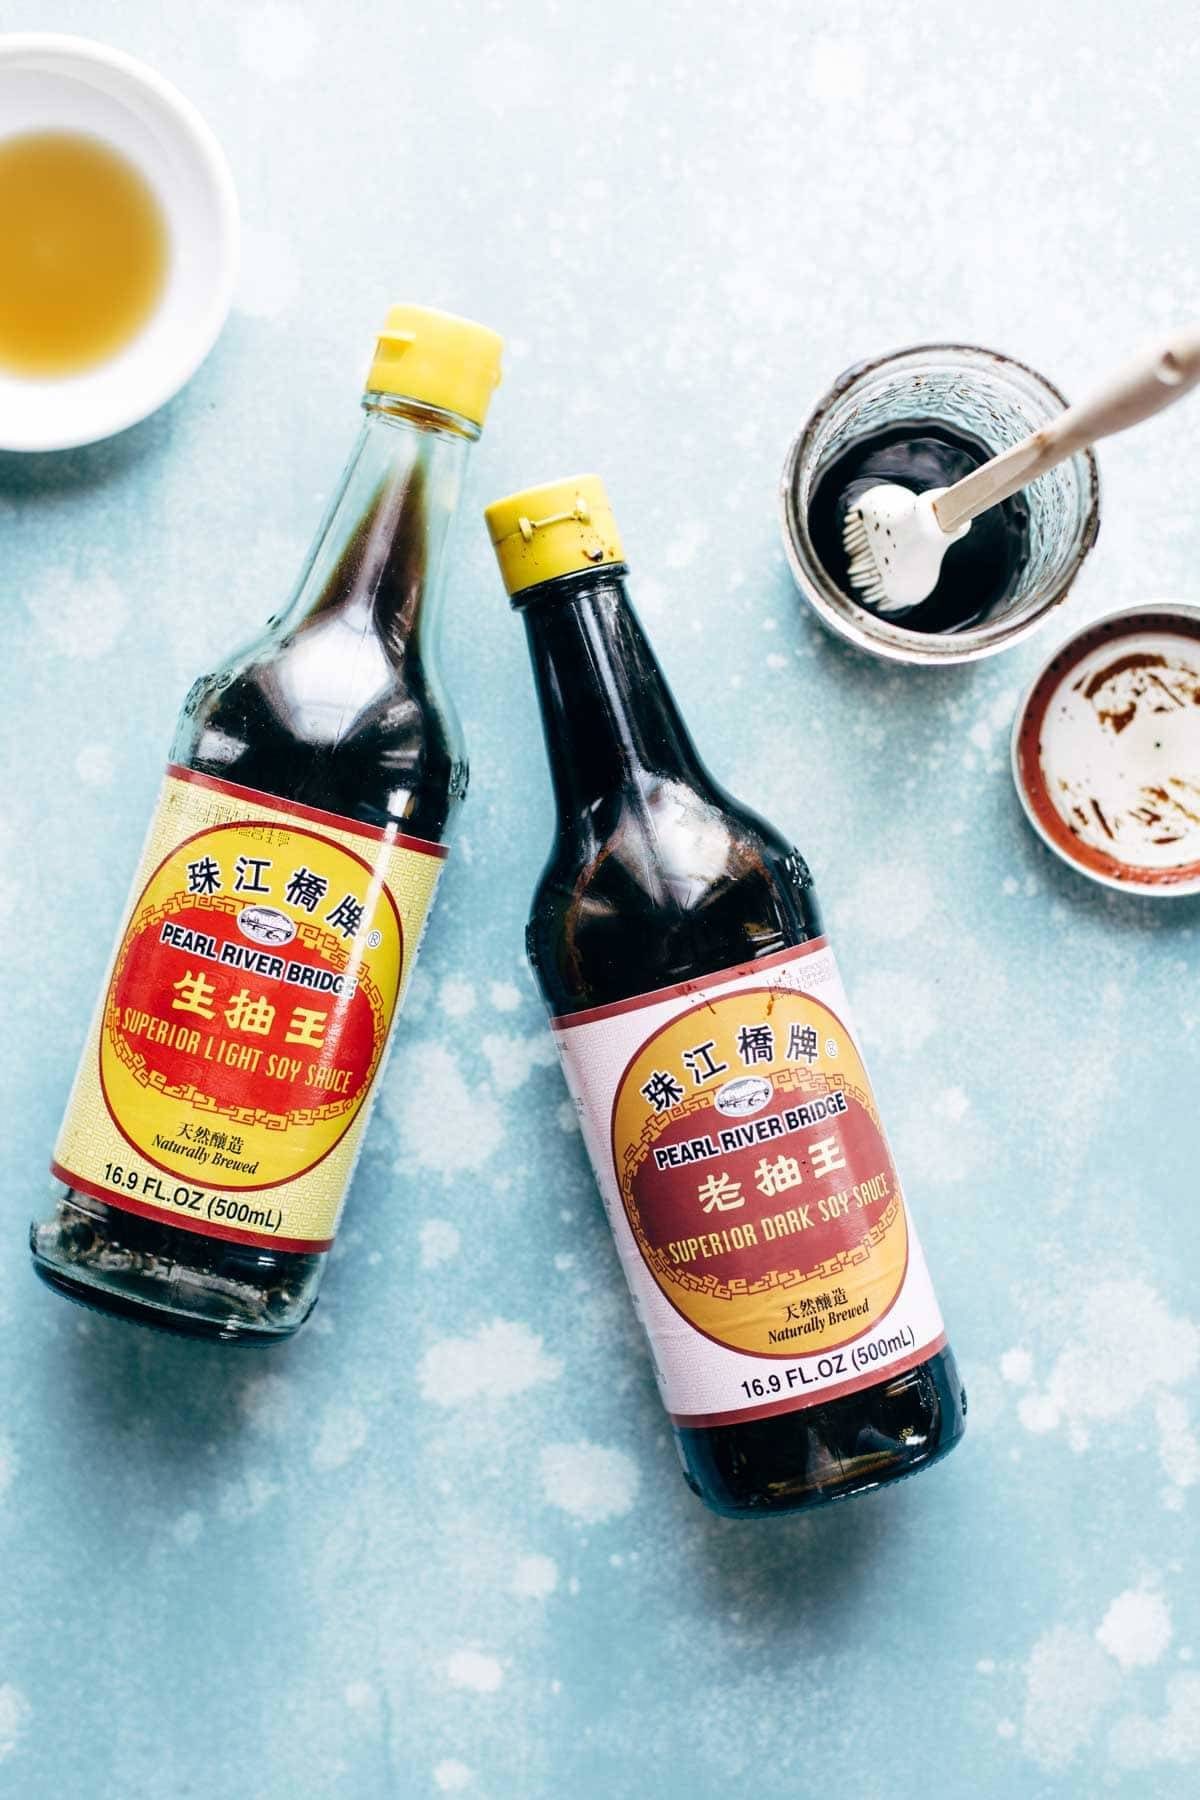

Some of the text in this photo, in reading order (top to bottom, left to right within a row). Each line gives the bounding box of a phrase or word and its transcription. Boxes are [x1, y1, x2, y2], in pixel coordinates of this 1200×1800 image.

[162, 923, 357, 997] PEARL RIVER BRIDGE
[171, 970, 329, 1049] 生抽王
[122, 1007, 353, 1094] SUPERIOR LIGHT SOY SAUCE
[642, 1024, 819, 1112] 珠江橋牌
[151, 1133, 259, 1175] Naturally Brewed
[176, 1122, 245, 1155] 天然釀造
[655, 1092, 847, 1169] PEARL RIVER BRIDGE
[104, 1163, 283, 1232] 16.9 FL.OZ (500mL)
[698, 1136, 847, 1214] 老抽王
[668, 1172, 891, 1265] SUPERIOR DARK SOY SAUCE
[768, 1298, 870, 1345] Naturally Brewed
[784, 1287, 849, 1322] 天然釀造
[741, 1325, 916, 1399] 16.9 FL.OZ (500mL)
